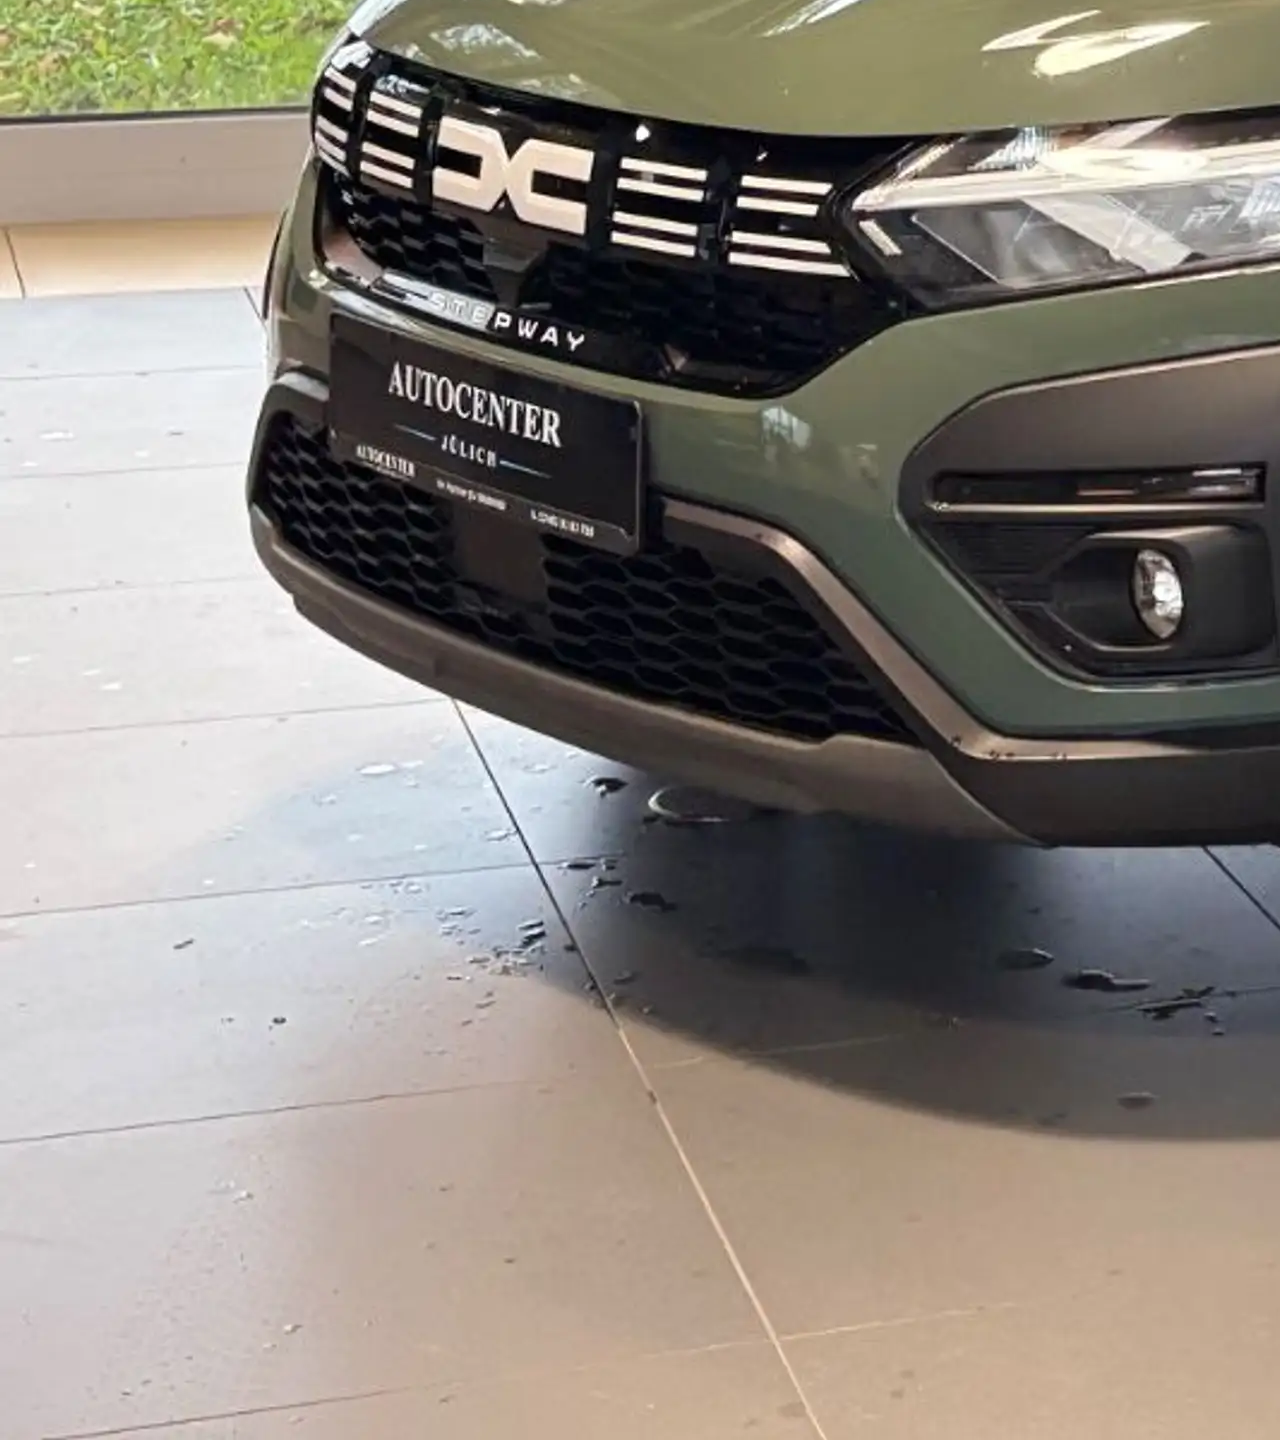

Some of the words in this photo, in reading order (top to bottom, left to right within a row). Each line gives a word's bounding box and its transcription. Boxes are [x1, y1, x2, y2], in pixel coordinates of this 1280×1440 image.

[428, 290, 586, 352] STEPWAY
[388, 361, 563, 448] AUTOCENTER
[440, 434, 497, 468] JÜLICH
